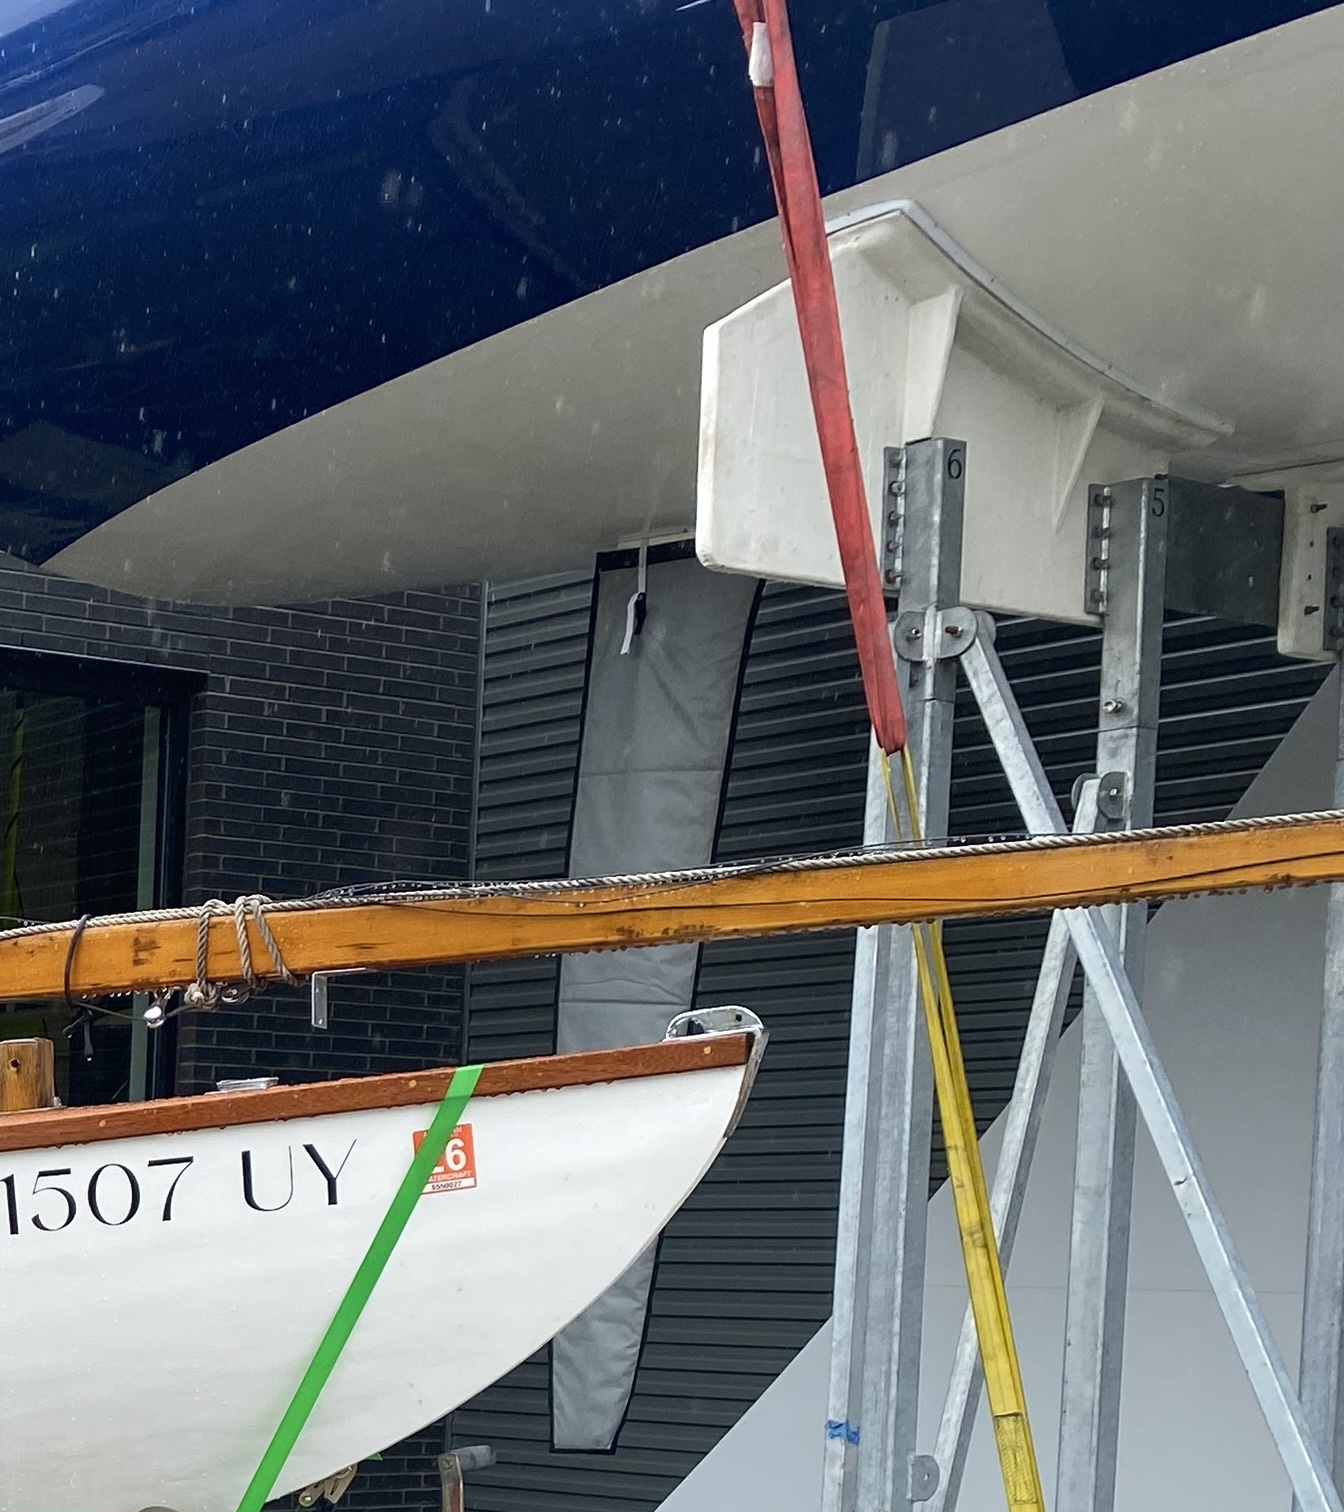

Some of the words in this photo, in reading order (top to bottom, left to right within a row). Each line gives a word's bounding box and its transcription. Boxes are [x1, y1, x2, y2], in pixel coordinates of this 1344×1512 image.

[948, 448, 962, 480] 6
[1152, 487, 1165, 517] 5
[241, 1138, 358, 1212] UY
[428, 1170, 473, 1182] ATERCRAFT
